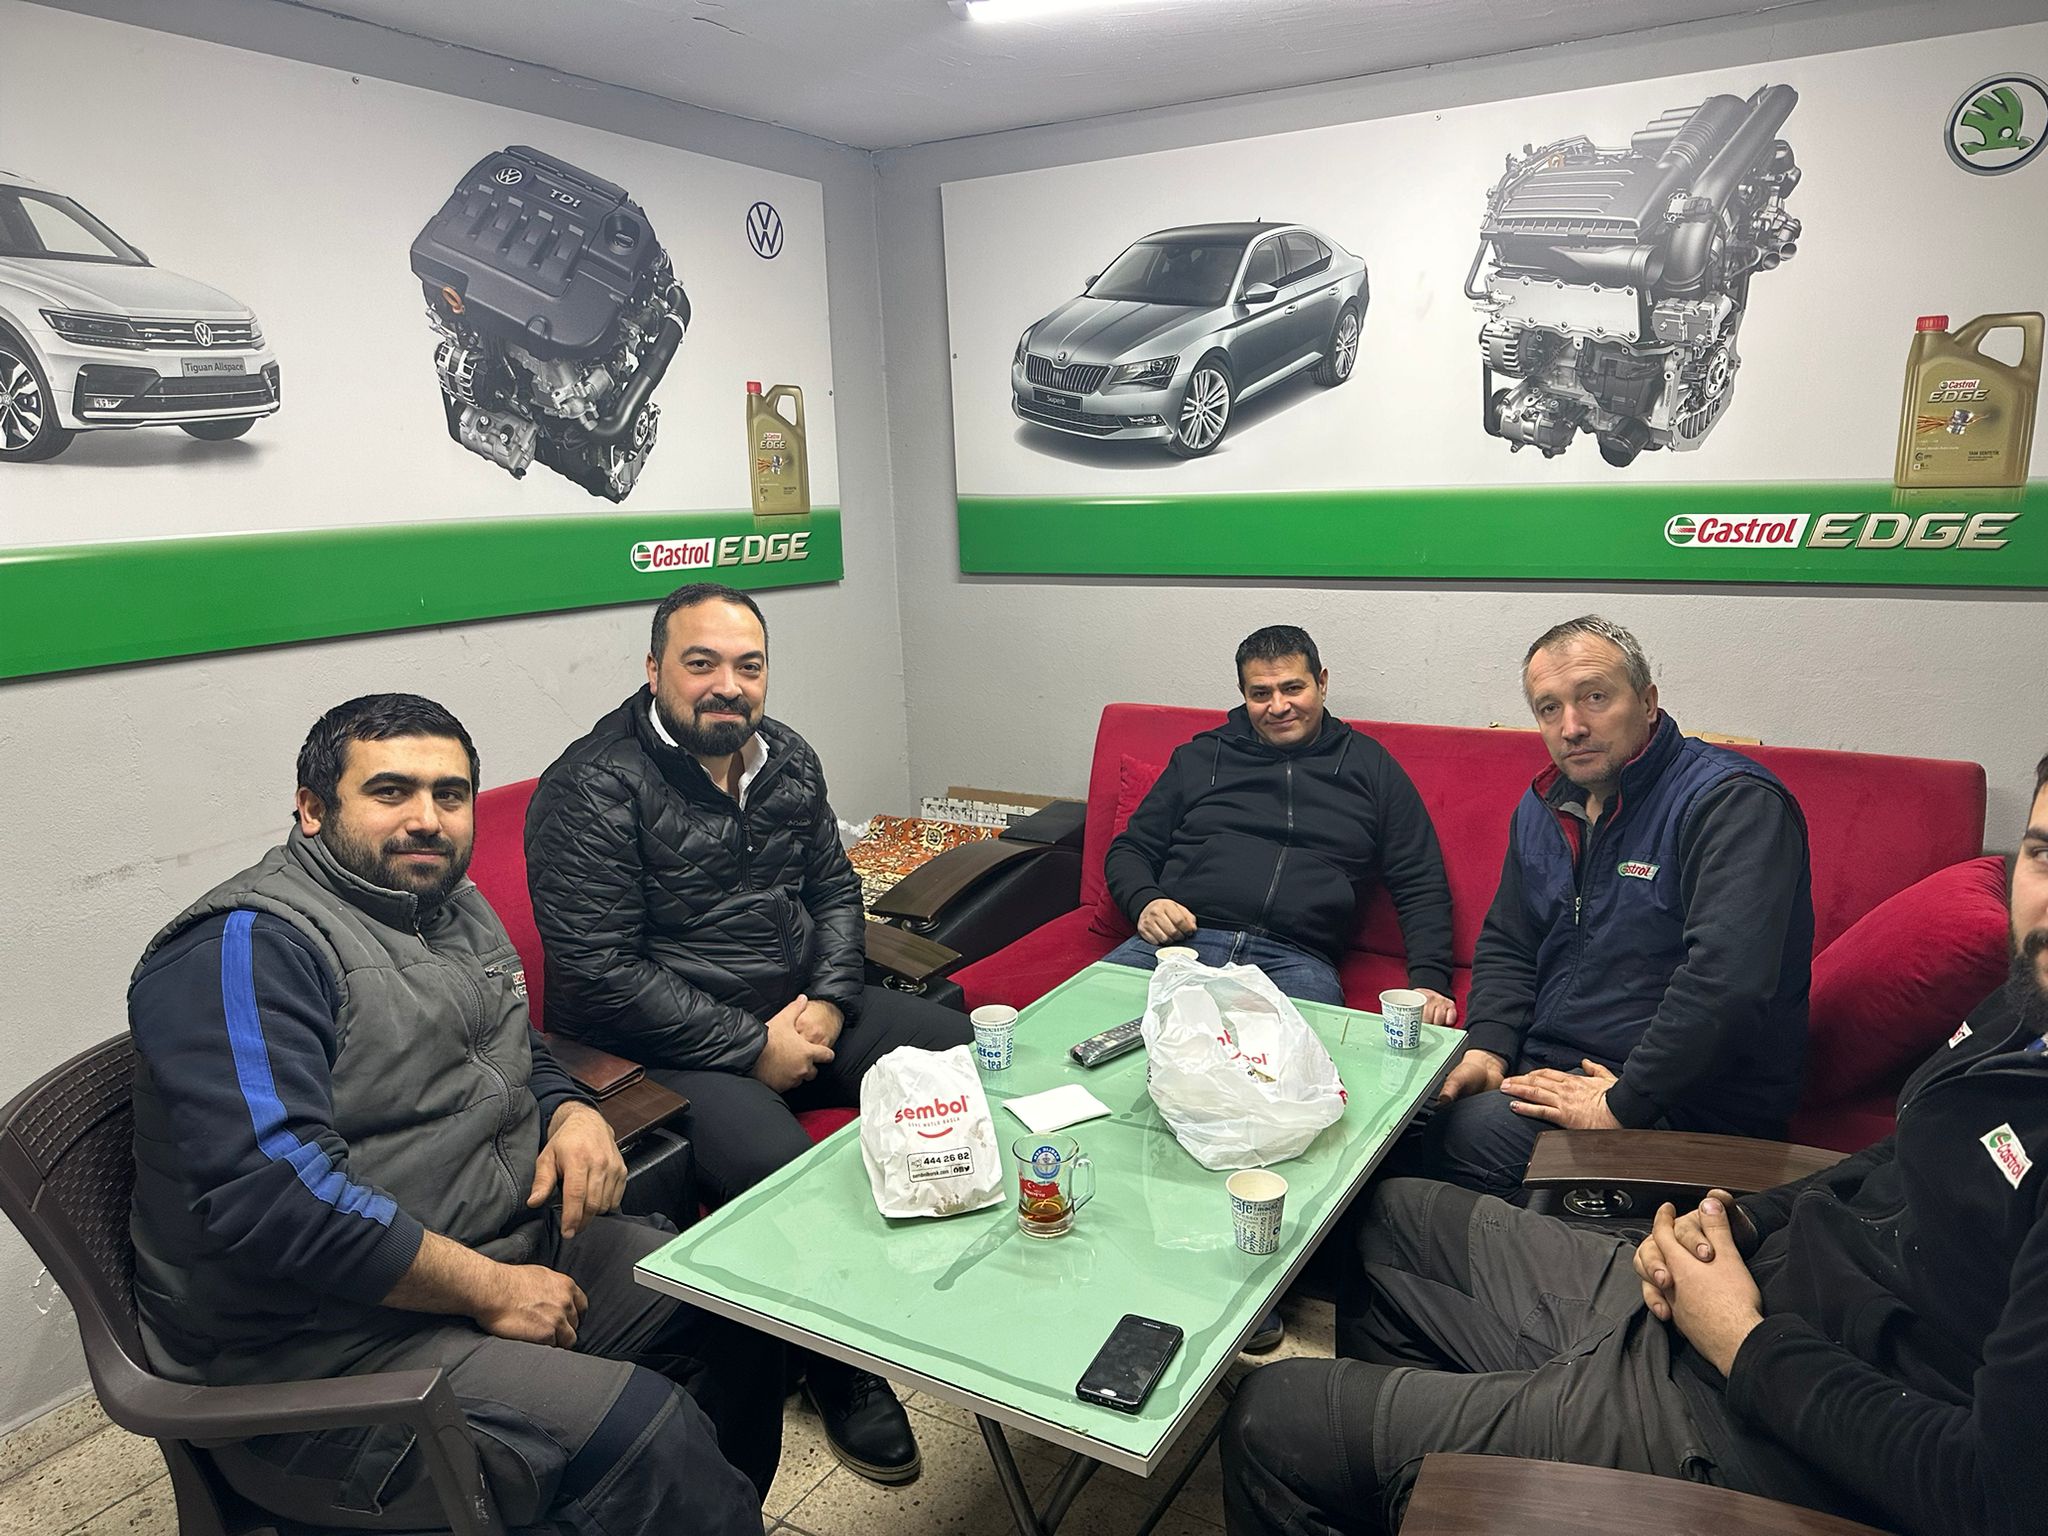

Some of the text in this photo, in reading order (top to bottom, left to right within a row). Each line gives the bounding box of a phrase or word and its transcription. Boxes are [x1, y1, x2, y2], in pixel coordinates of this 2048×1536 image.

[550, 189, 581, 208] TDI
[184, 362, 243, 374] Tiguan Allspace
[1949, 381, 1977, 389] Castrol
[1928, 389, 1990, 403] EDGE
[1697, 512, 2023, 549] Castrol EDGE
[653, 531, 812, 568] Castrol EDGE
[1390, 1036, 1404, 1048] tea
[987, 1059, 1002, 1069] tea
[895, 1095, 968, 1124] sembol
[923, 1151, 970, 1165] 444 26 82
[1996, 1143, 2026, 1180] Castrol
